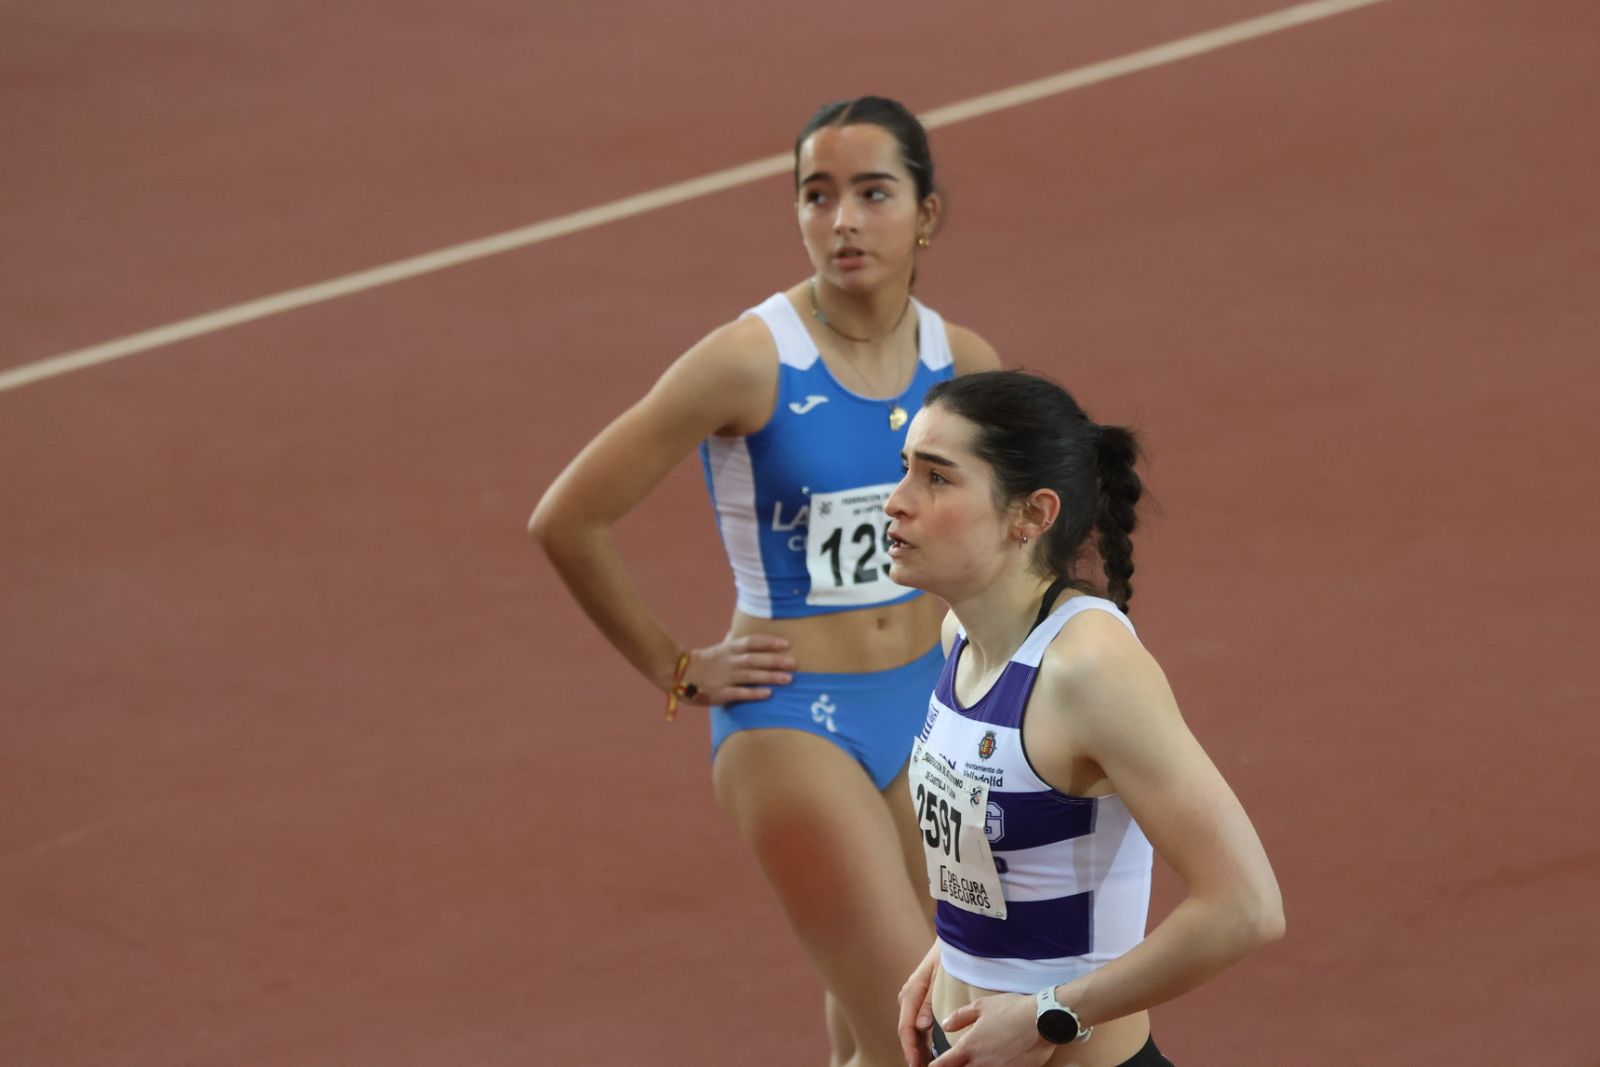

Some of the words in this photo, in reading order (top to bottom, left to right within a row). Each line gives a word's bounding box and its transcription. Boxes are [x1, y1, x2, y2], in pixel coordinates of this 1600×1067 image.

[916, 783, 962, 864] 2597
[947, 870, 961, 888] DEL
[960, 878, 988, 897] CURA
[948, 884, 992, 909] SEGUROS
